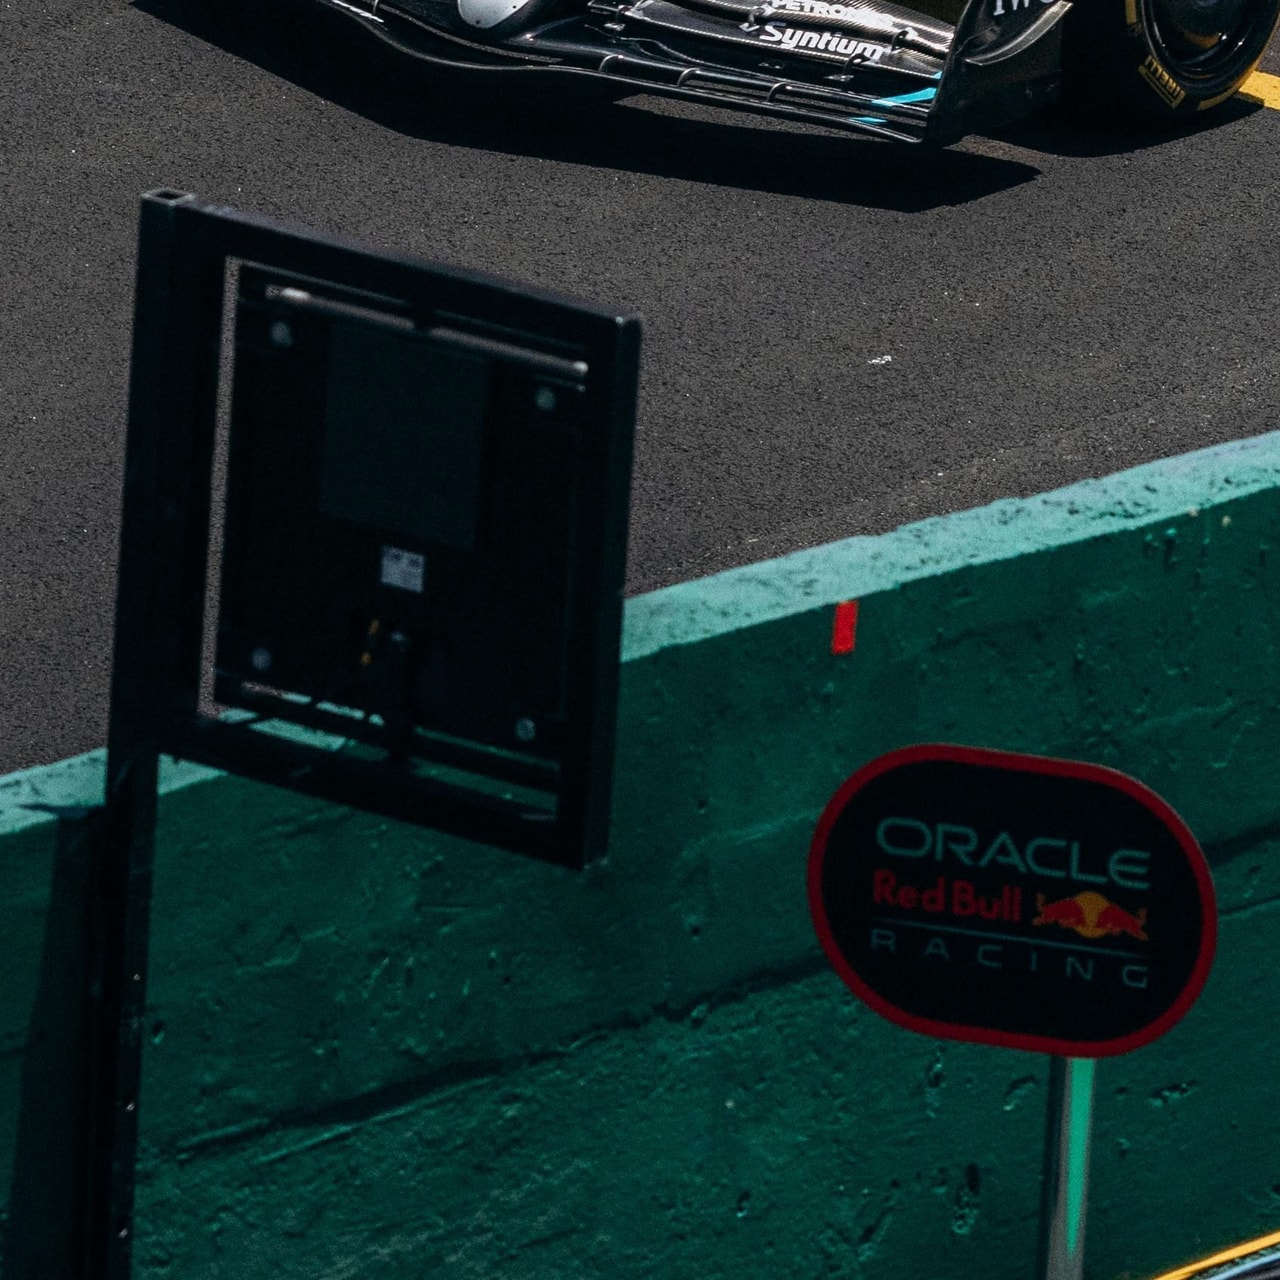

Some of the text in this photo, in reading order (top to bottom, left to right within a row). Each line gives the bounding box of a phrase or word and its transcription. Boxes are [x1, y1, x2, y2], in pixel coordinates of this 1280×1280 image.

[760, 21, 885, 63] Syntium
[875, 816, 1151, 890] ORACLE
[873, 869, 1022, 924] Red Bull
[869, 928, 1149, 989] RACING
